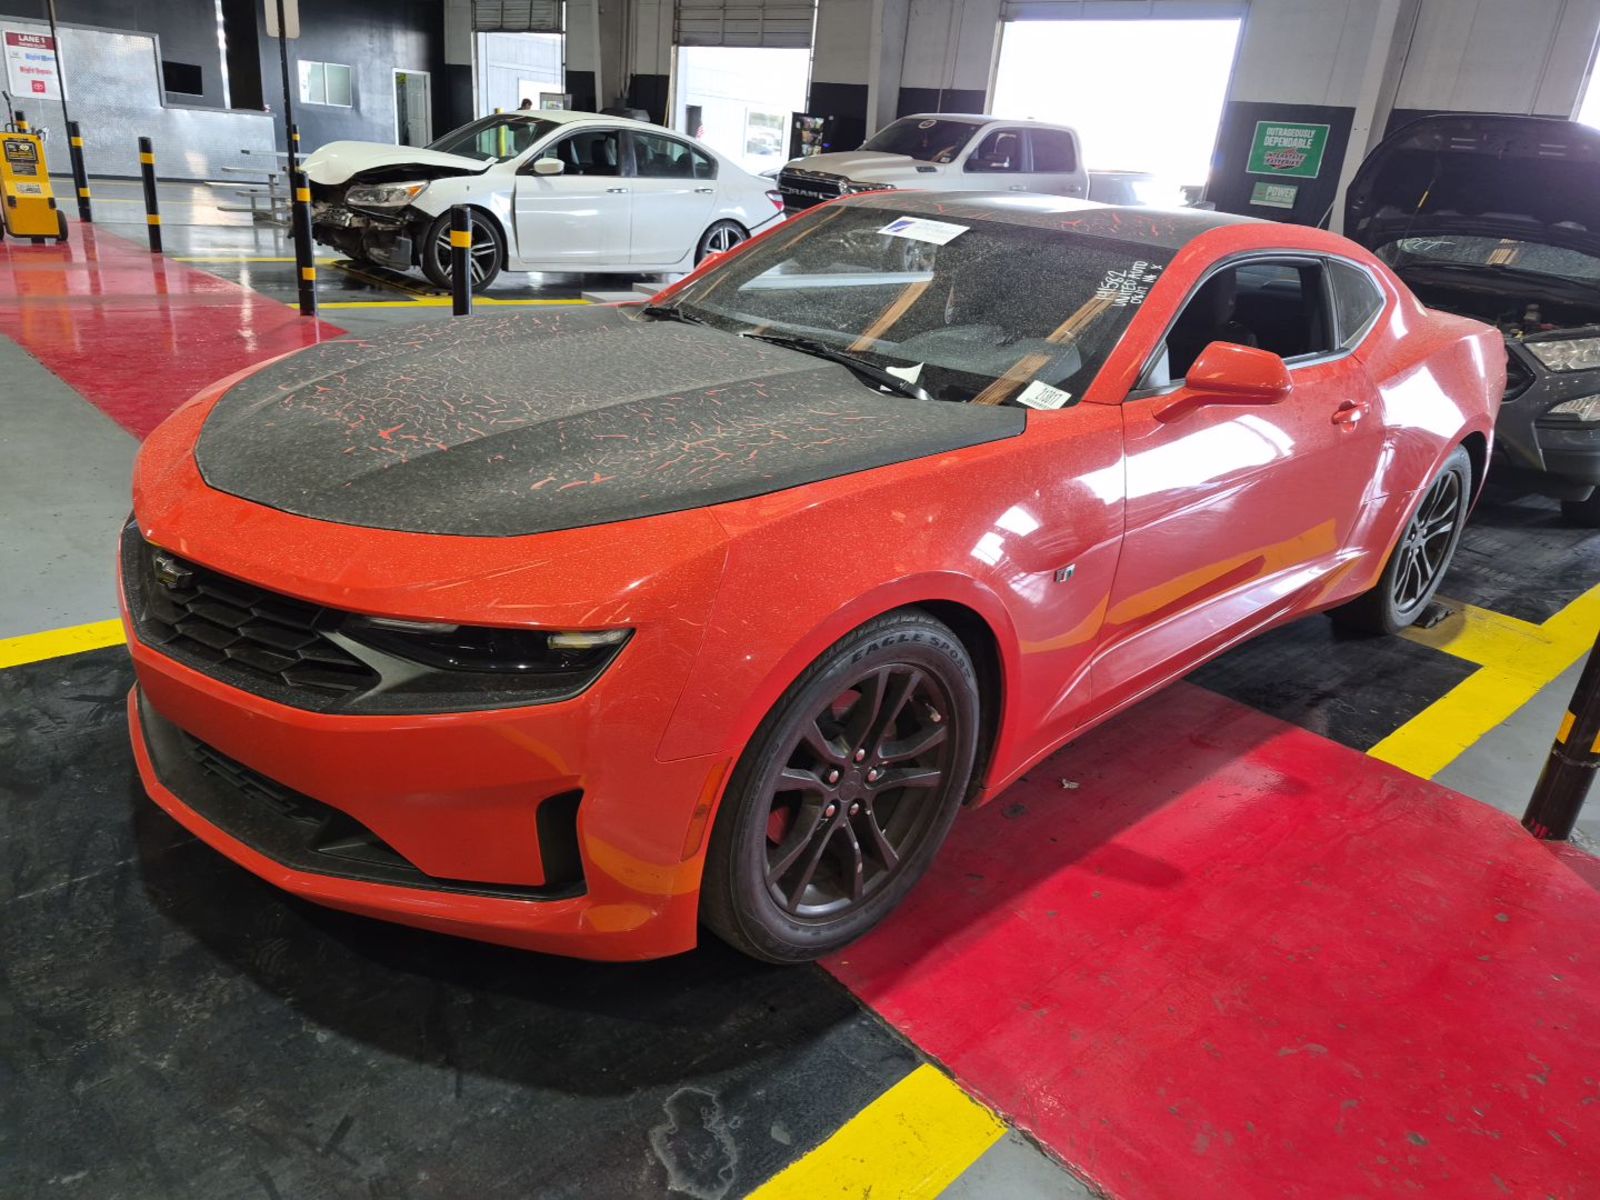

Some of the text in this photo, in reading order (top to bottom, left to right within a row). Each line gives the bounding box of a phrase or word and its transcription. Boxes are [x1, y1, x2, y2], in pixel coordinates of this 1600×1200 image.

[18, 34, 40, 43] LANE
[1266, 127, 1316, 138] OUTRAGEOUSLY
[1264, 136, 1313, 149] DEPENDABLE
[791, 188, 818, 198] RAM
[1266, 186, 1296, 198] POWER
[1111, 260, 1149, 307] UNITED AUTO
[851, 633, 972, 679] EAGLE SPORT
